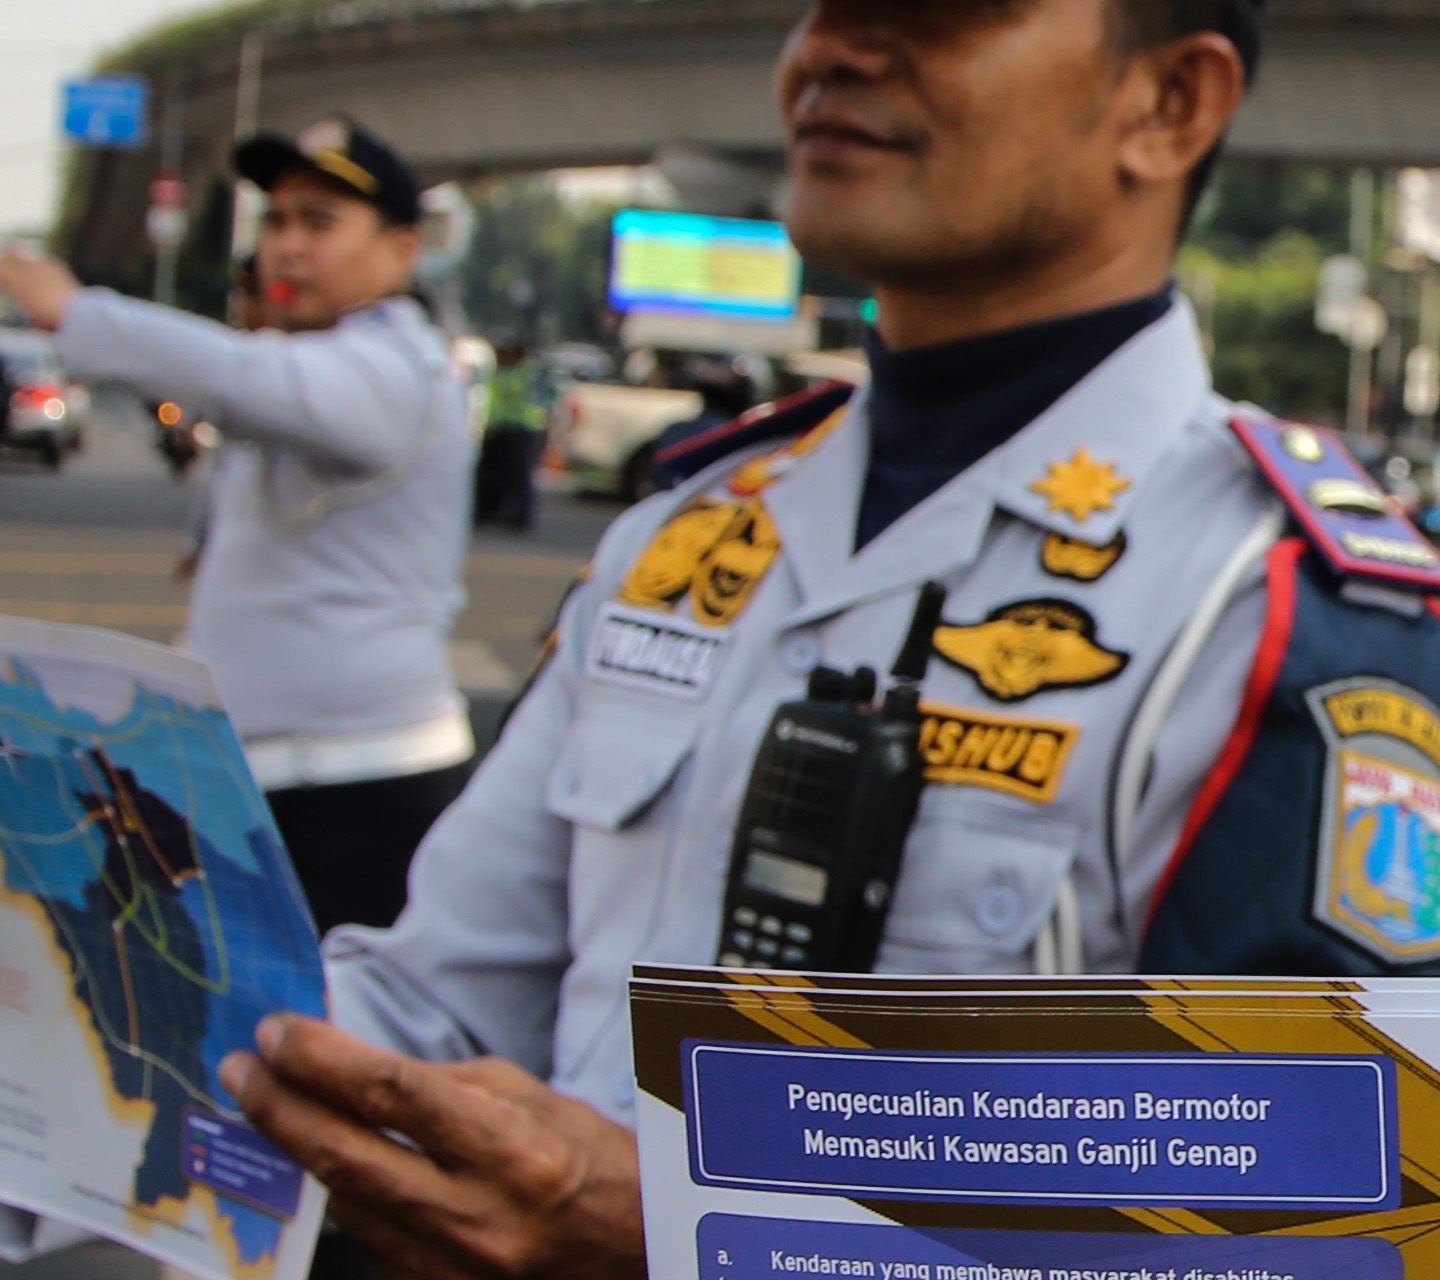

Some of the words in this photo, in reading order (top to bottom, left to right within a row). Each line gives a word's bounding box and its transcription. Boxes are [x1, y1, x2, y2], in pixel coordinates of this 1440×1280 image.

[918, 714, 1059, 783] ISHUB
[787, 1083, 965, 1121] Pengecualian
[972, 1090, 1126, 1120] Kendaraan
[1134, 1092, 1272, 1121] Bermotor
[803, 1128, 936, 1161] Memasuki
[943, 1134, 1068, 1165] Kawasan
[1076, 1137, 1158, 1174] Ganjil
[1166, 1138, 1258, 1175] Genap
[770, 1250, 875, 1277] Kendaraan
